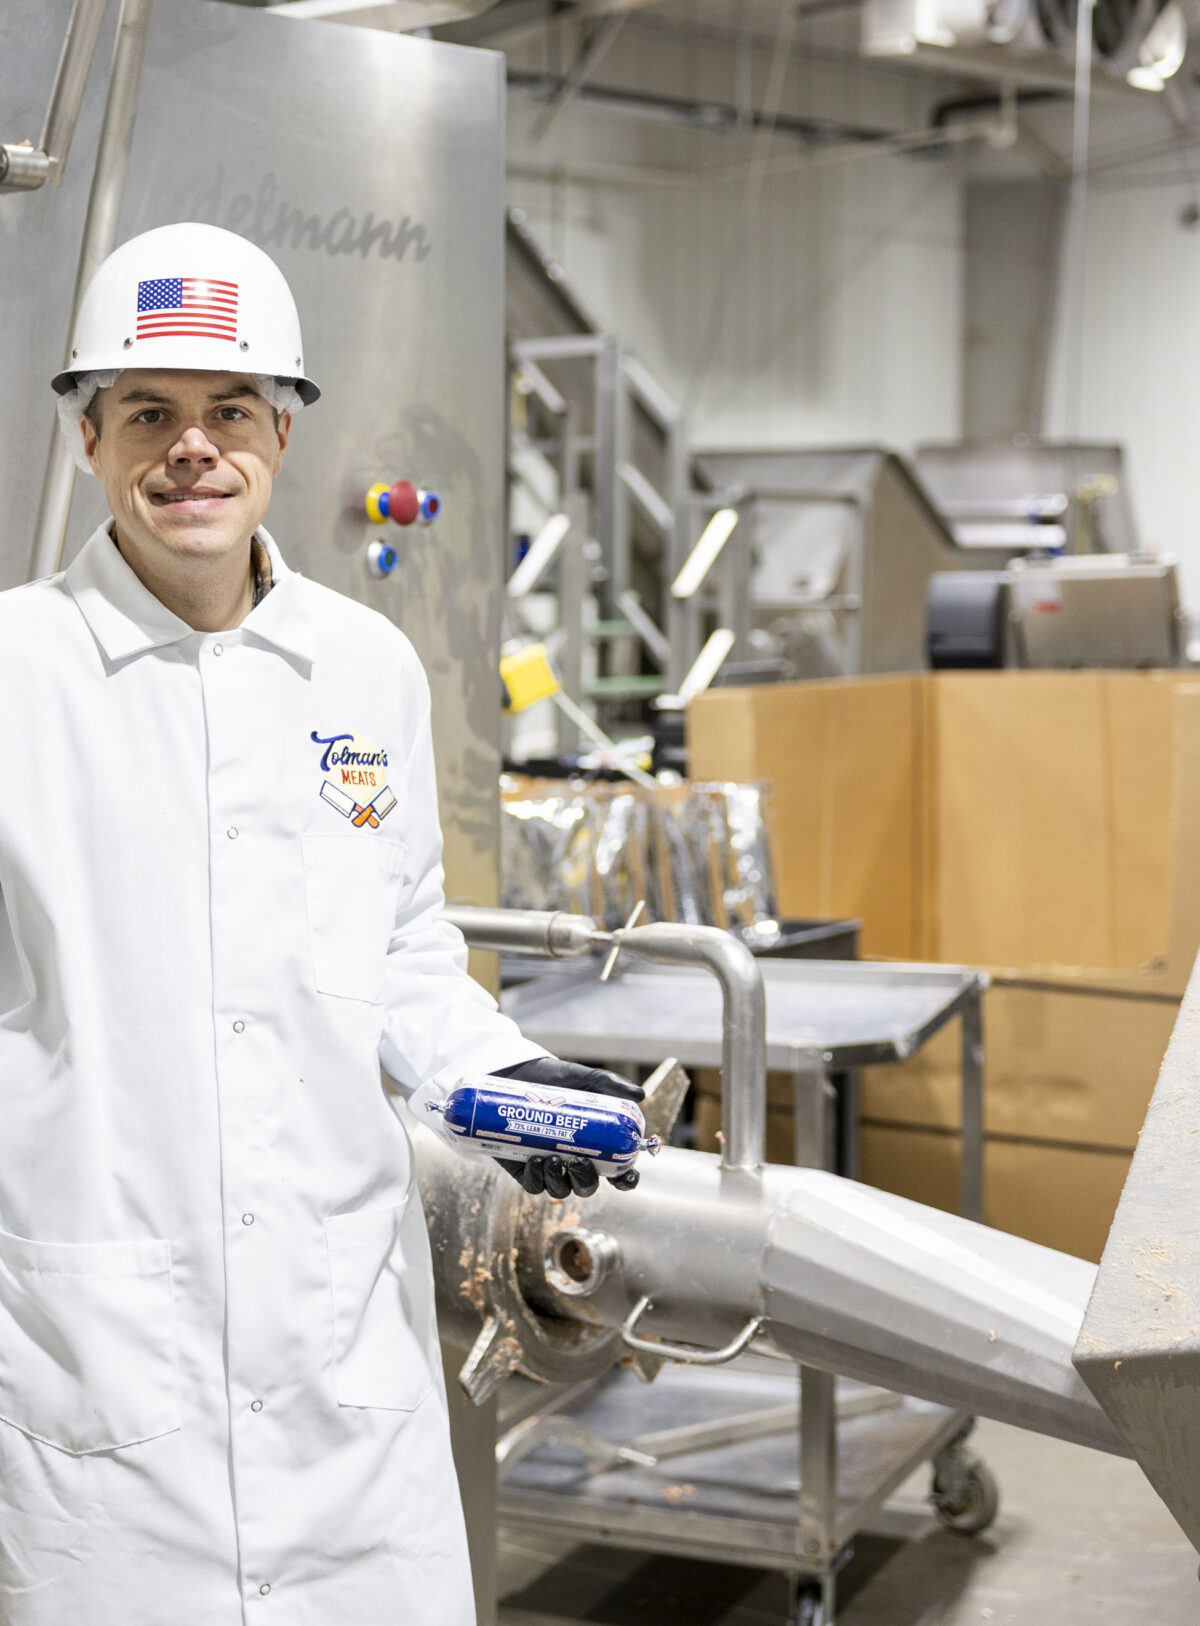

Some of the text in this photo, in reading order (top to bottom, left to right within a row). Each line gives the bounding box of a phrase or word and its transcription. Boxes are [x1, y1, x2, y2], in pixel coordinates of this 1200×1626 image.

[310, 730, 388, 772] Tolman's
[340, 768, 377, 787] MEATS
[497, 1105, 589, 1130] GROUND BEEF
[526, 1124, 541, 1132] LEAN
[557, 1129, 568, 1137] FAT
